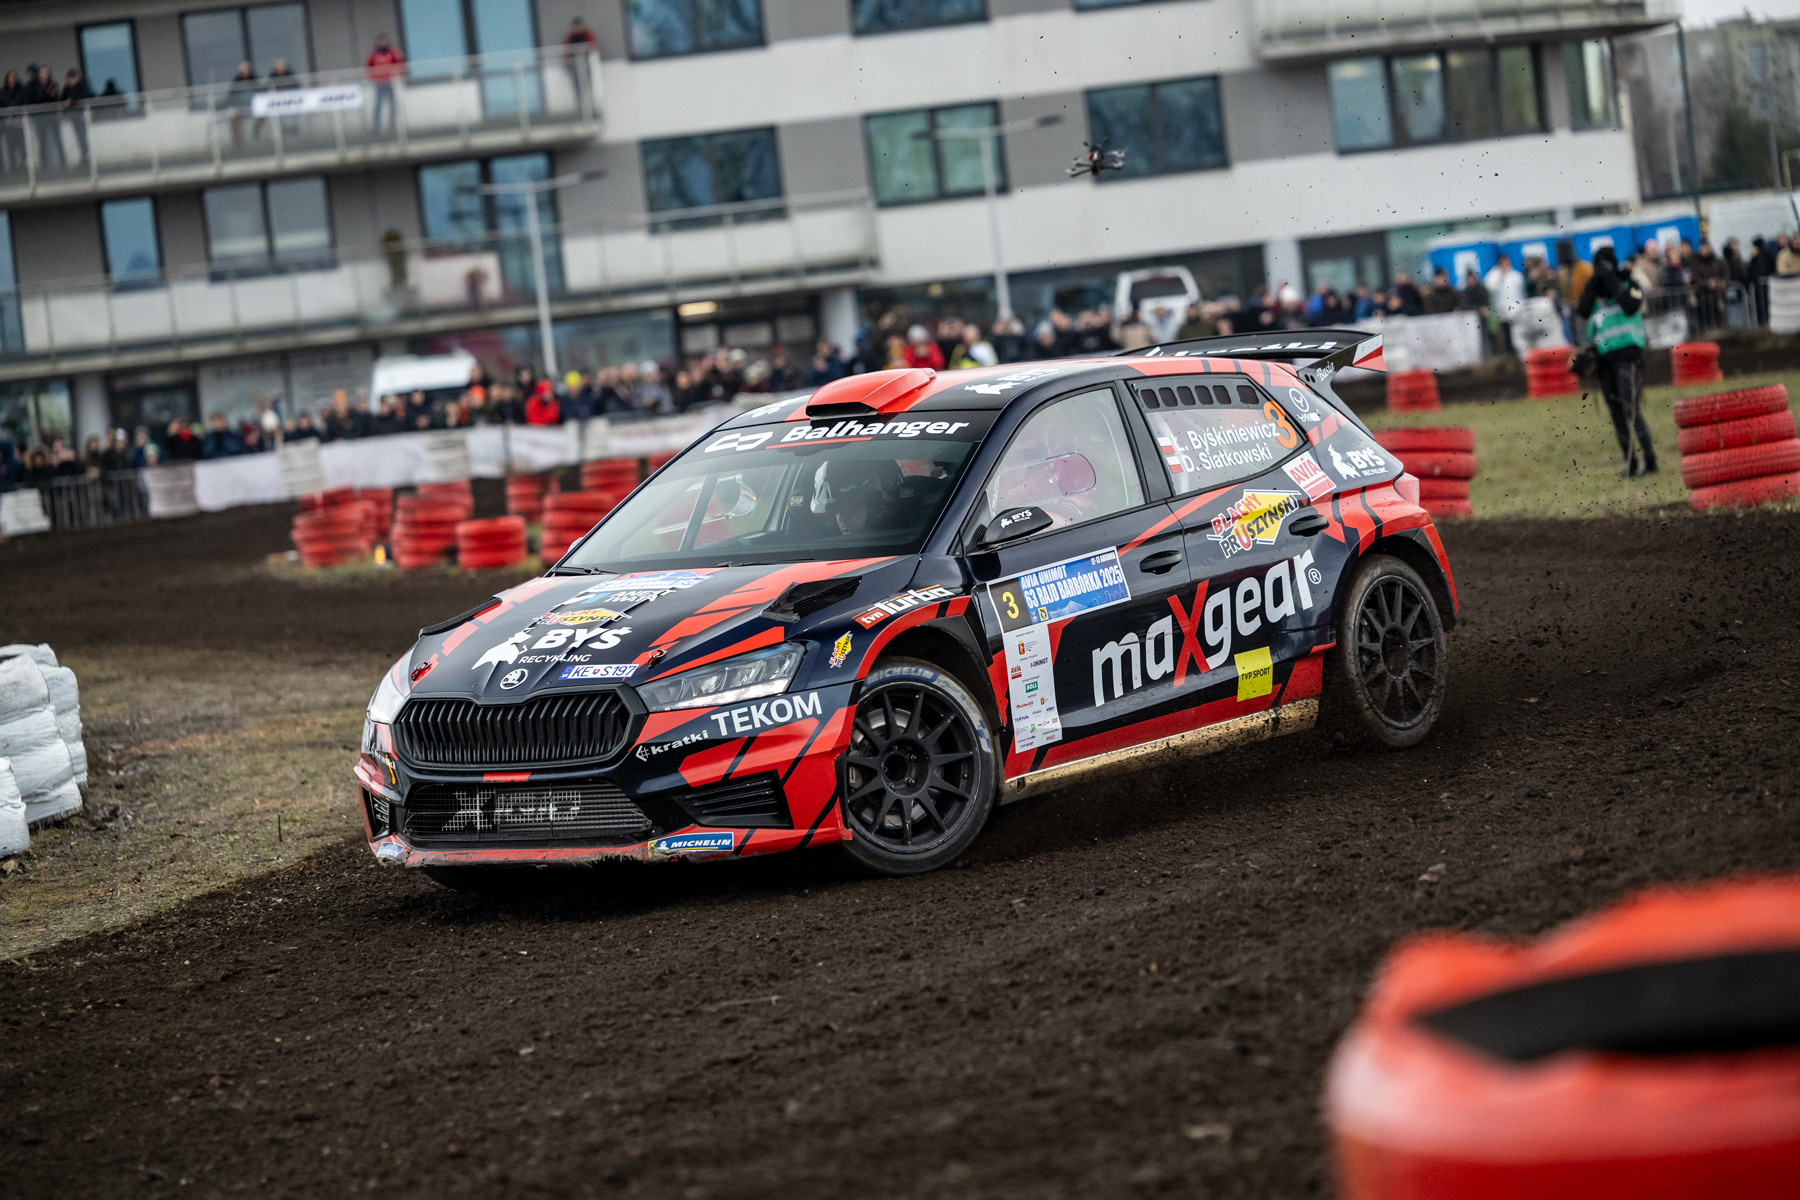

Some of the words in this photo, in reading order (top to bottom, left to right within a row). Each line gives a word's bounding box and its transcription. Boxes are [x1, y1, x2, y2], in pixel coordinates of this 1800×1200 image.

[1316, 361, 1335, 382] Basia
[780, 420, 970, 443] Balhanger
[1186, 421, 1281, 452] Byśkiniewicz
[1263, 400, 1298, 449] 3
[1182, 455, 1201, 473] D.
[1198, 442, 1274, 471] Siatkowski
[1211, 493, 1262, 536] BLACHY
[1020, 573, 1040, 590] AVIA
[1038, 565, 1068, 585] UNIMOT
[1023, 588, 1039, 609] 63
[1036, 583, 1060, 606] RAJD
[1056, 572, 1104, 600] BARBÓRKA
[1100, 565, 1124, 588] 2025
[861, 610, 884, 625] tvn
[1002, 591, 1020, 620] 3
[518, 654, 593, 664] RECYKLING
[572, 666, 593, 677] KE
[600, 666, 637, 677] S197
[866, 666, 934, 686] MICHELIN
[1241, 671, 1252, 681] TVP
[1252, 667, 1271, 679] SPORT
[710, 691, 823, 737] TEKOM
[650, 729, 709, 755] kratki
[671, 838, 732, 848] MICHELIN
